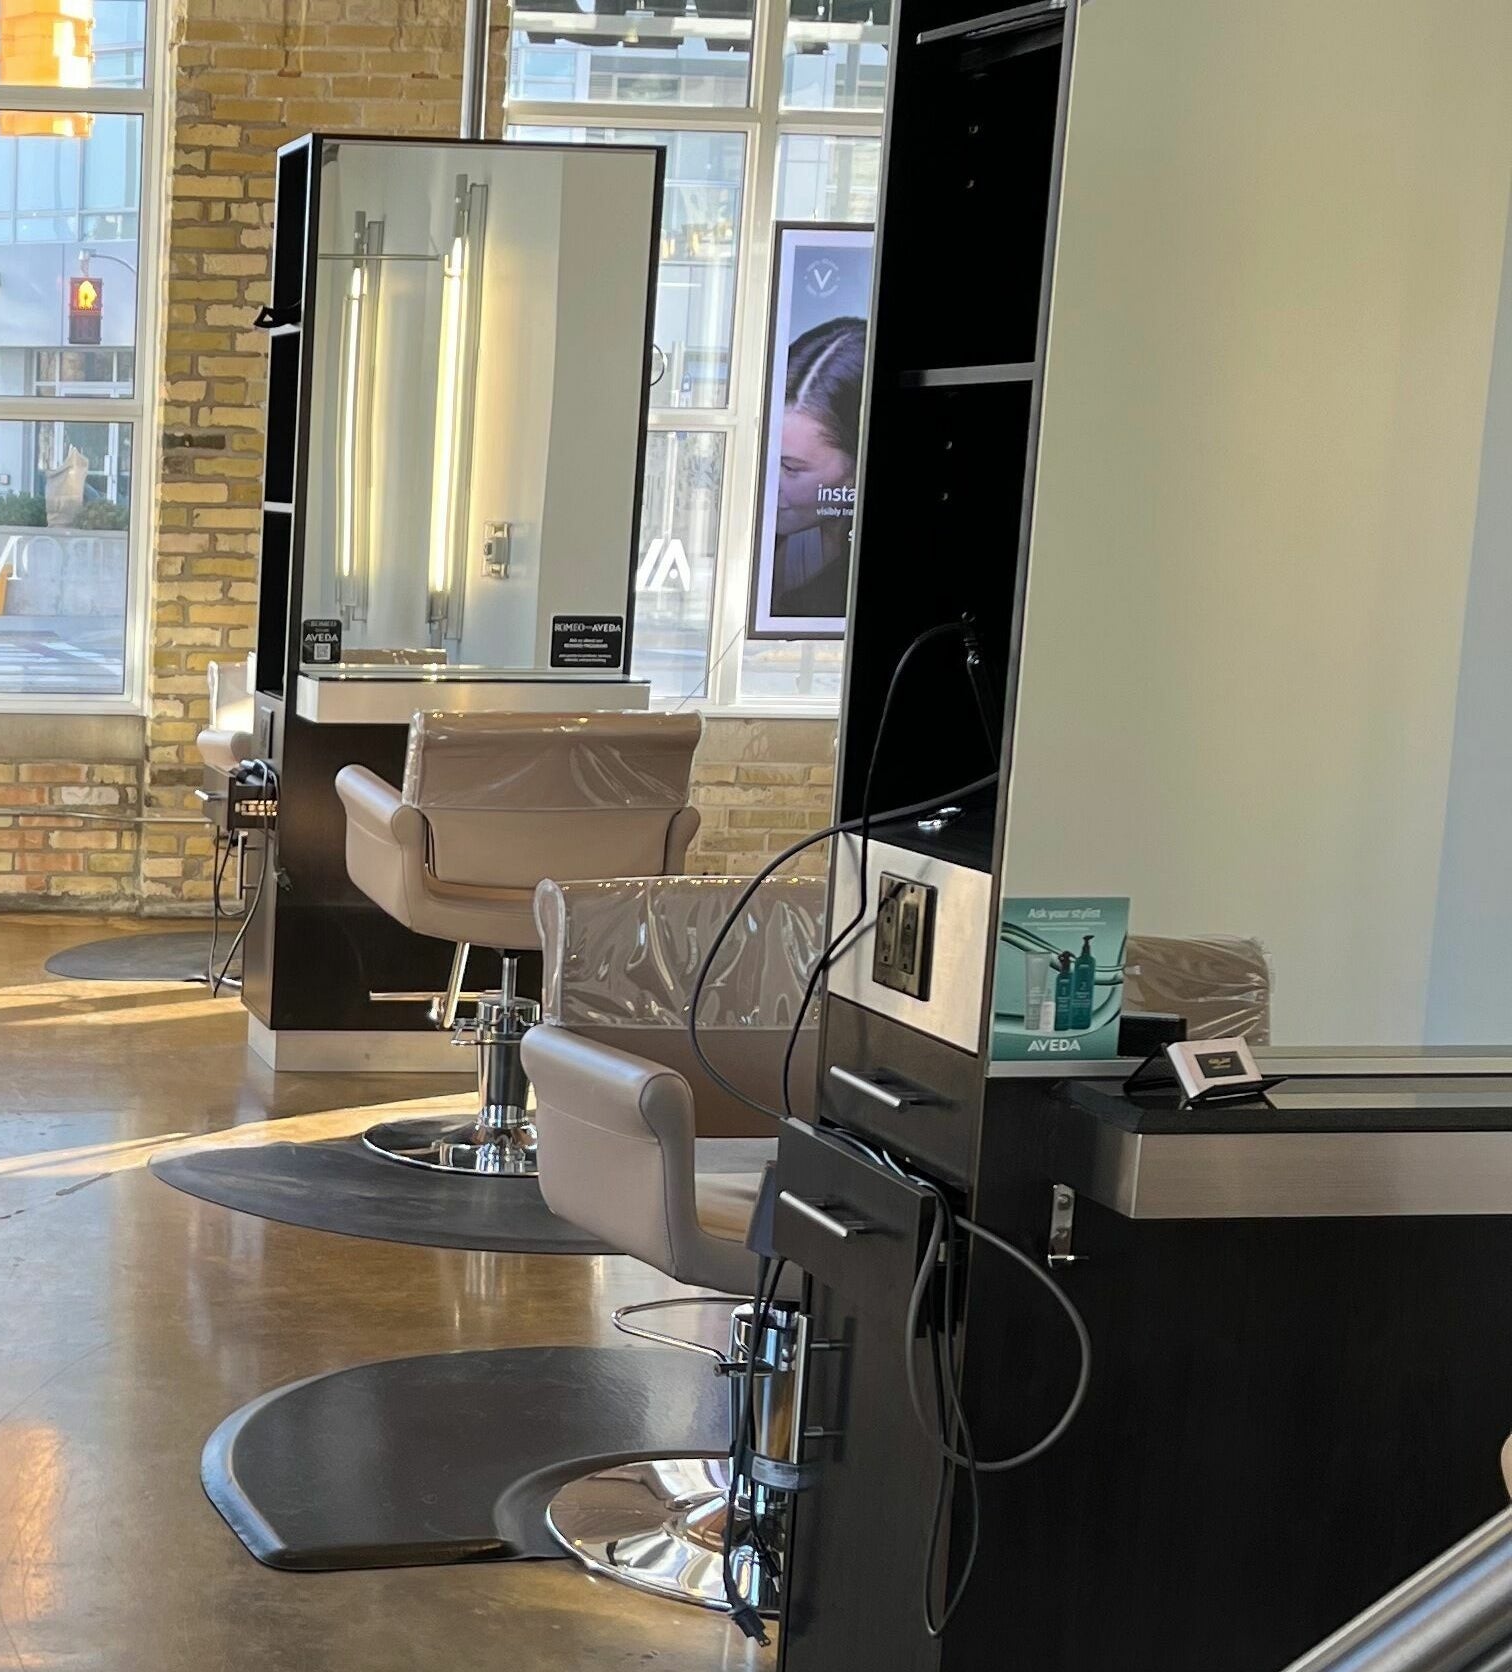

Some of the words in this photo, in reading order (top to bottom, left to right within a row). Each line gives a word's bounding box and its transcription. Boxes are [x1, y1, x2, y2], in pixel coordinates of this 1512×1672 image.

[817, 484, 856, 502] insta
[591, 623, 622, 633] AVEDA
[304, 633, 339, 642] AVEDA
[1027, 908, 1047, 918] Ask
[1048, 909, 1070, 919] your
[1071, 908, 1101, 920] stylist
[1027, 1039, 1081, 1052] AVEDA
